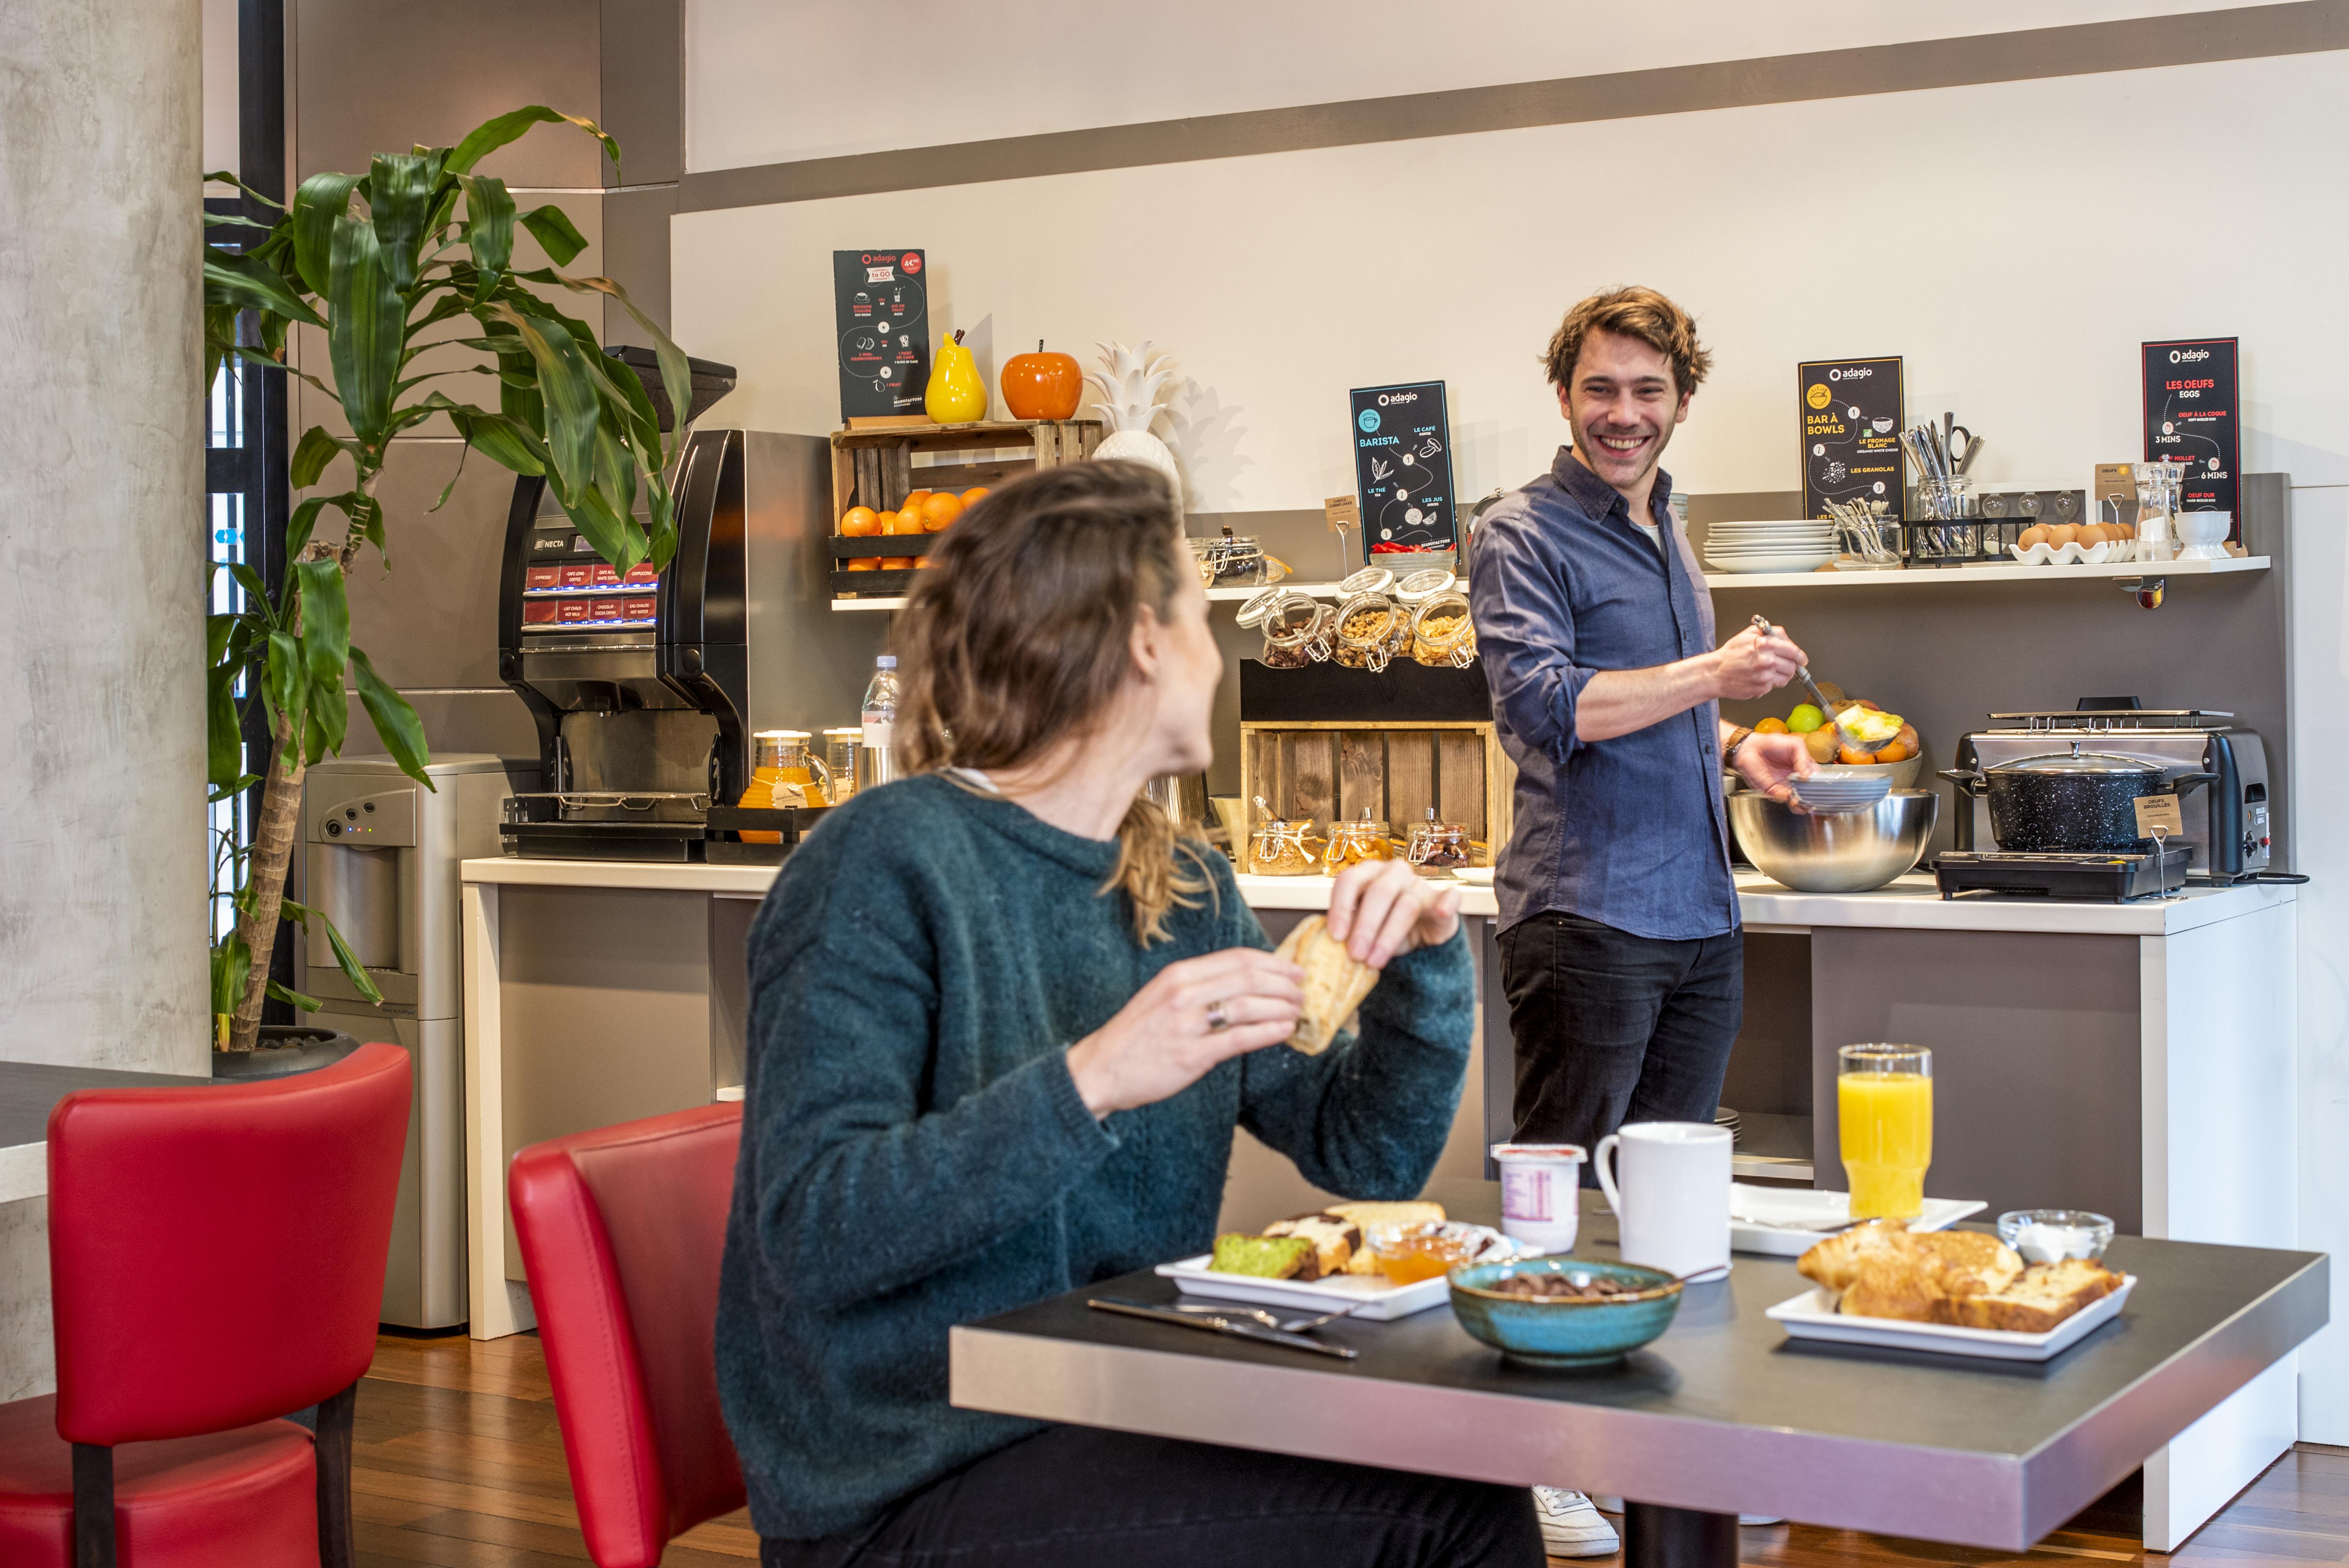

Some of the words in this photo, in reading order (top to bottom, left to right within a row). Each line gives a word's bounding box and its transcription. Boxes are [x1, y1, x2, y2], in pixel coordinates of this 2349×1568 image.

[873, 254, 896, 263] adagio
[2182, 349, 2210, 361] adagio
[1843, 367, 1872, 379] adagio
[2166, 380, 2182, 390] LES
[2184, 379, 2214, 389] OEUFS
[1390, 392, 1418, 403] adagio
[1807, 415, 1828, 424] BAR
[1830, 412, 1838, 423] À
[1808, 425, 1845, 435] BOWLS
[1360, 436, 1400, 447] BARISTA
